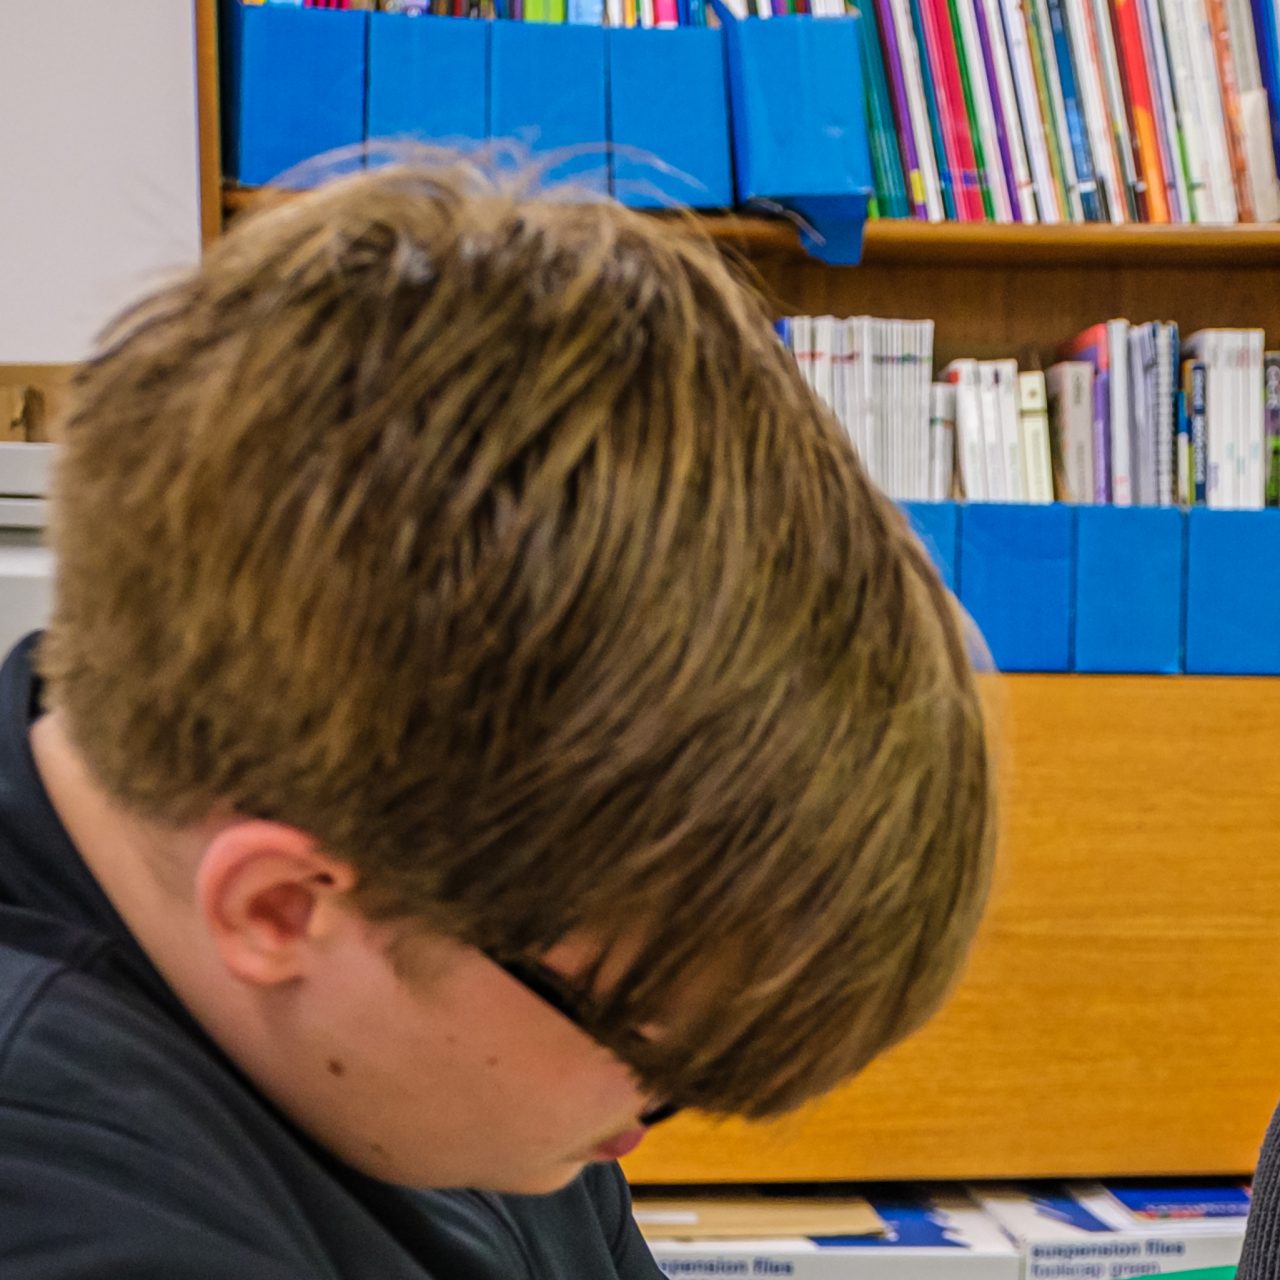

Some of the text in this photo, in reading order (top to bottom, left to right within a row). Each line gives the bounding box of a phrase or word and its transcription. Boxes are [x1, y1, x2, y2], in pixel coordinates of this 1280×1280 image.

[1032, 1239, 1185, 1259] suspension files
[660, 1257, 793, 1275] spension files
[1110, 1261, 1161, 1279] green
